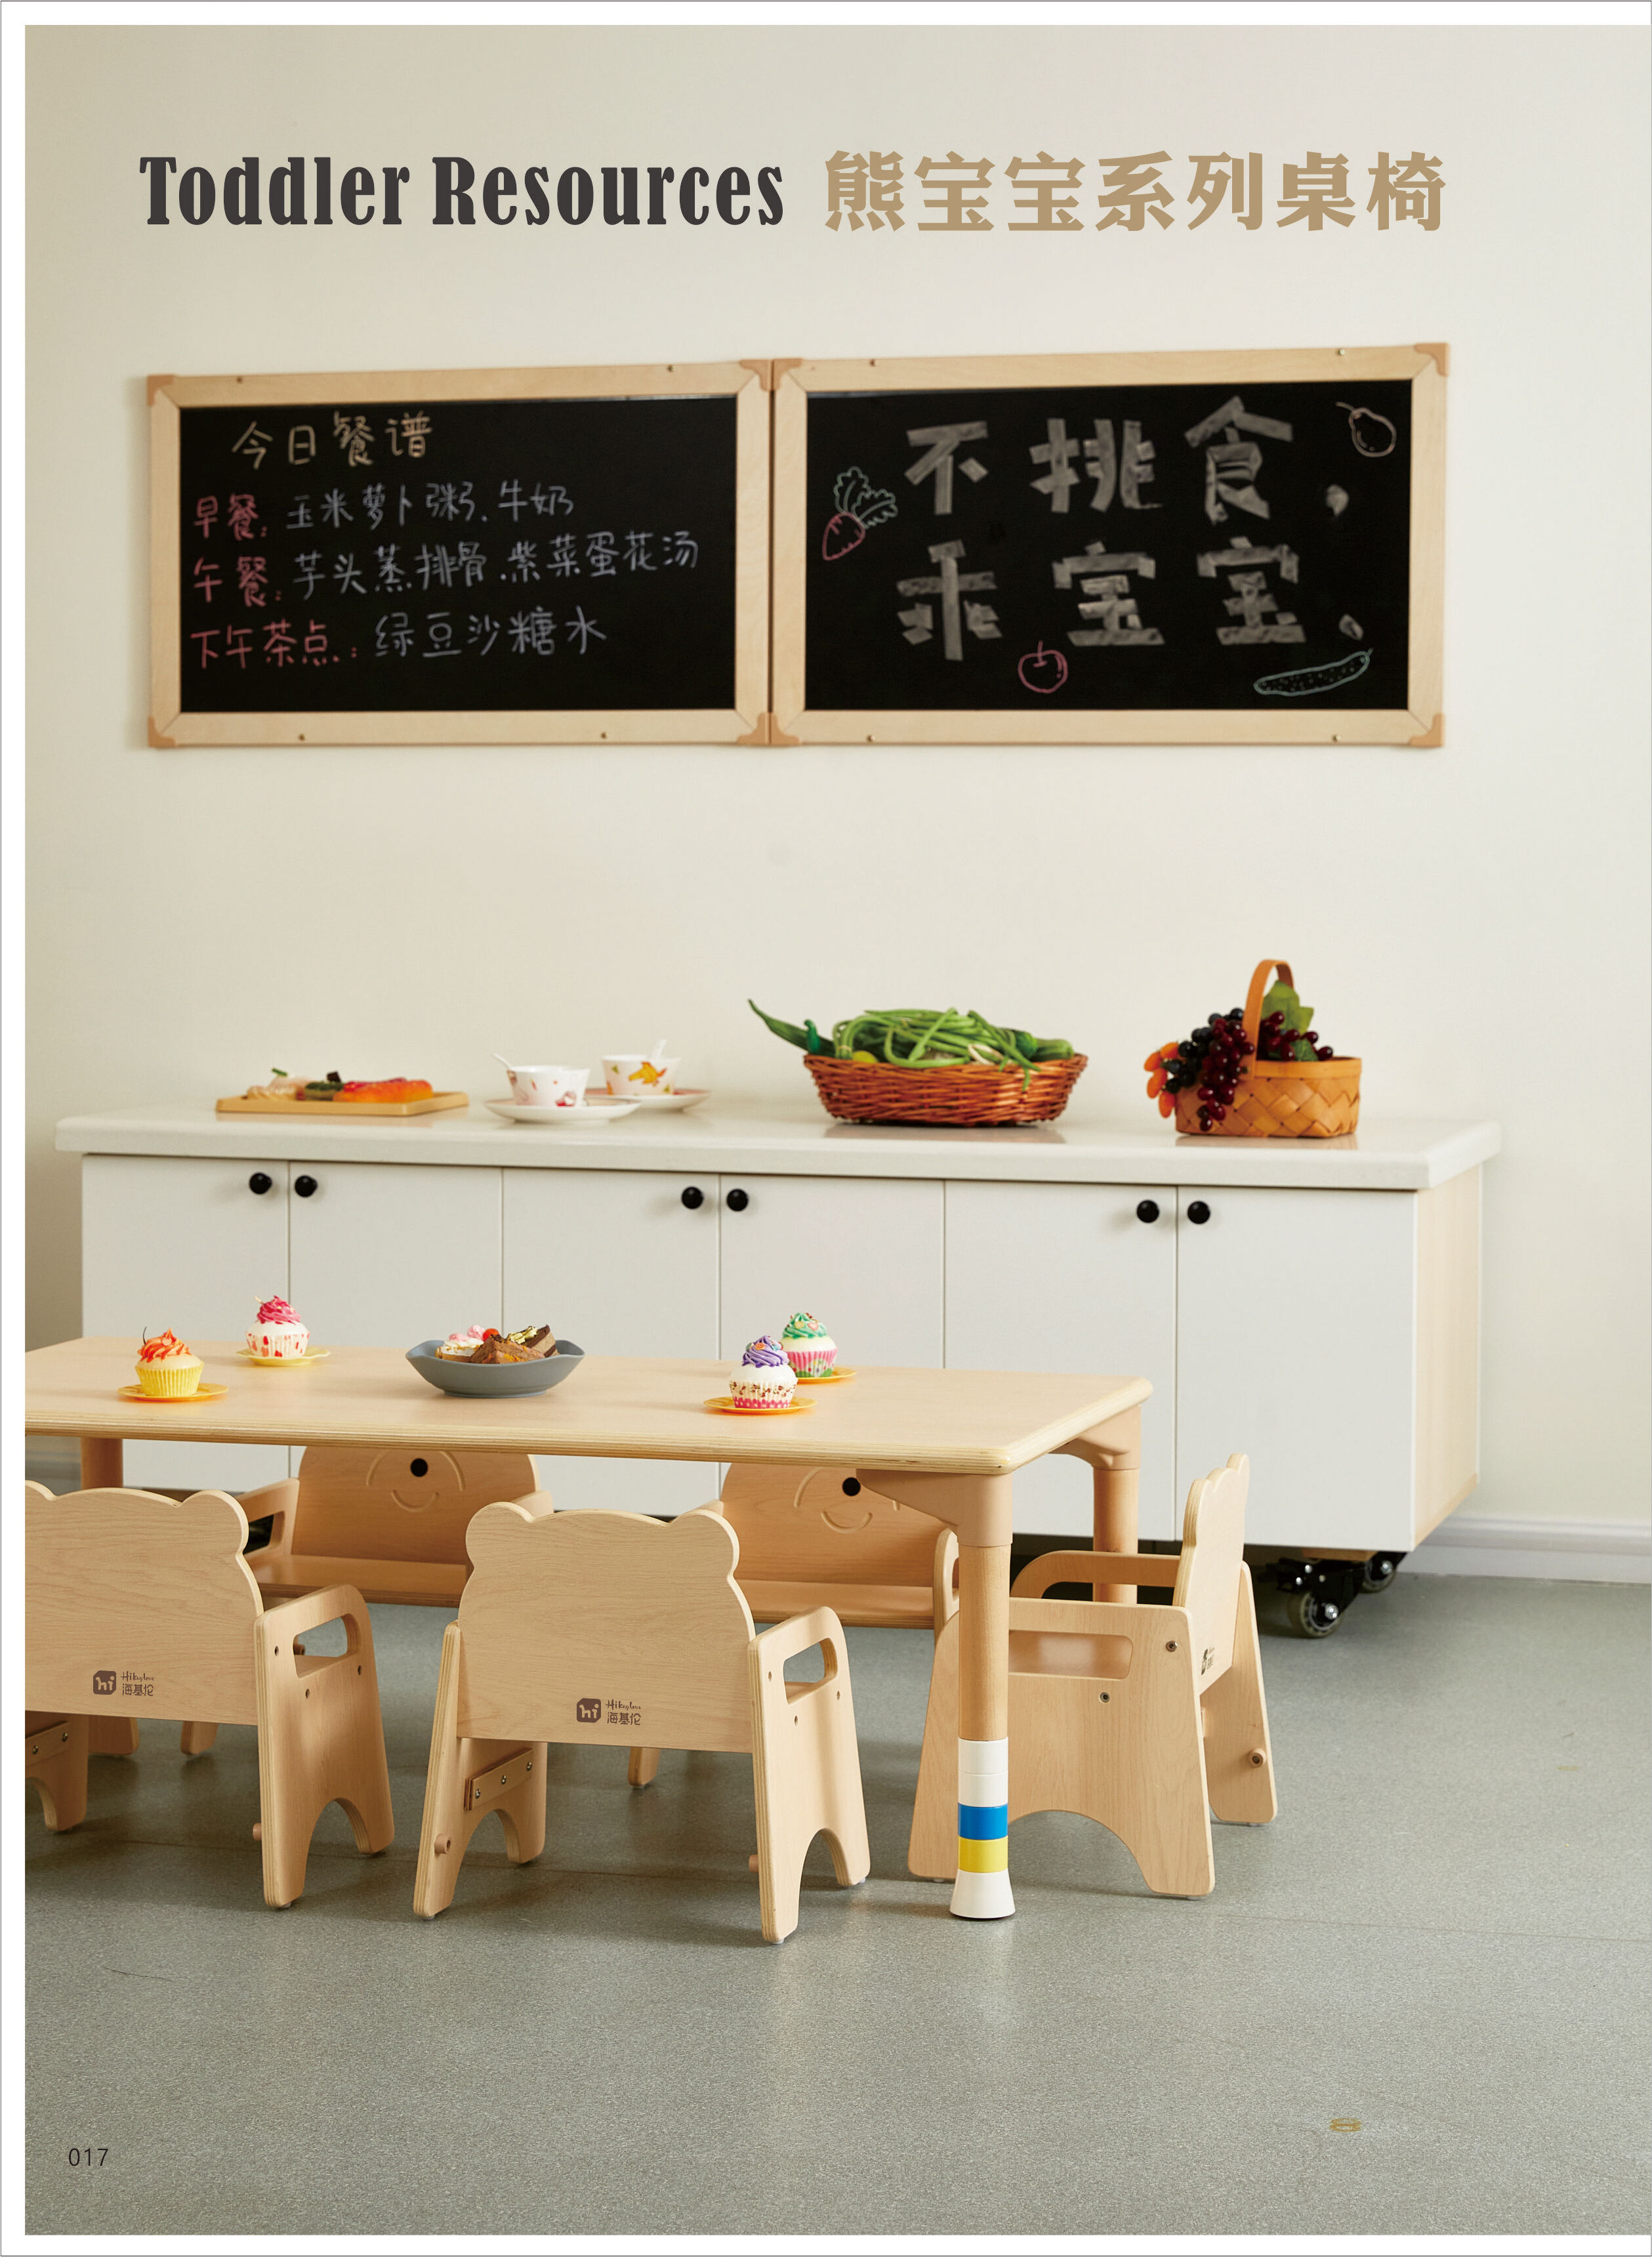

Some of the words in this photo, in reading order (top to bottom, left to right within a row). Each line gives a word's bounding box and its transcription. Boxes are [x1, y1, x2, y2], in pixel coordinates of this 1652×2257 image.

[232, 411, 432, 469] 今日餐谱
[375, 606, 607, 657] 绿豆沙糖水
[122, 1683, 154, 1696] 海基伦
[607, 1711, 642, 1726] 海基伦
